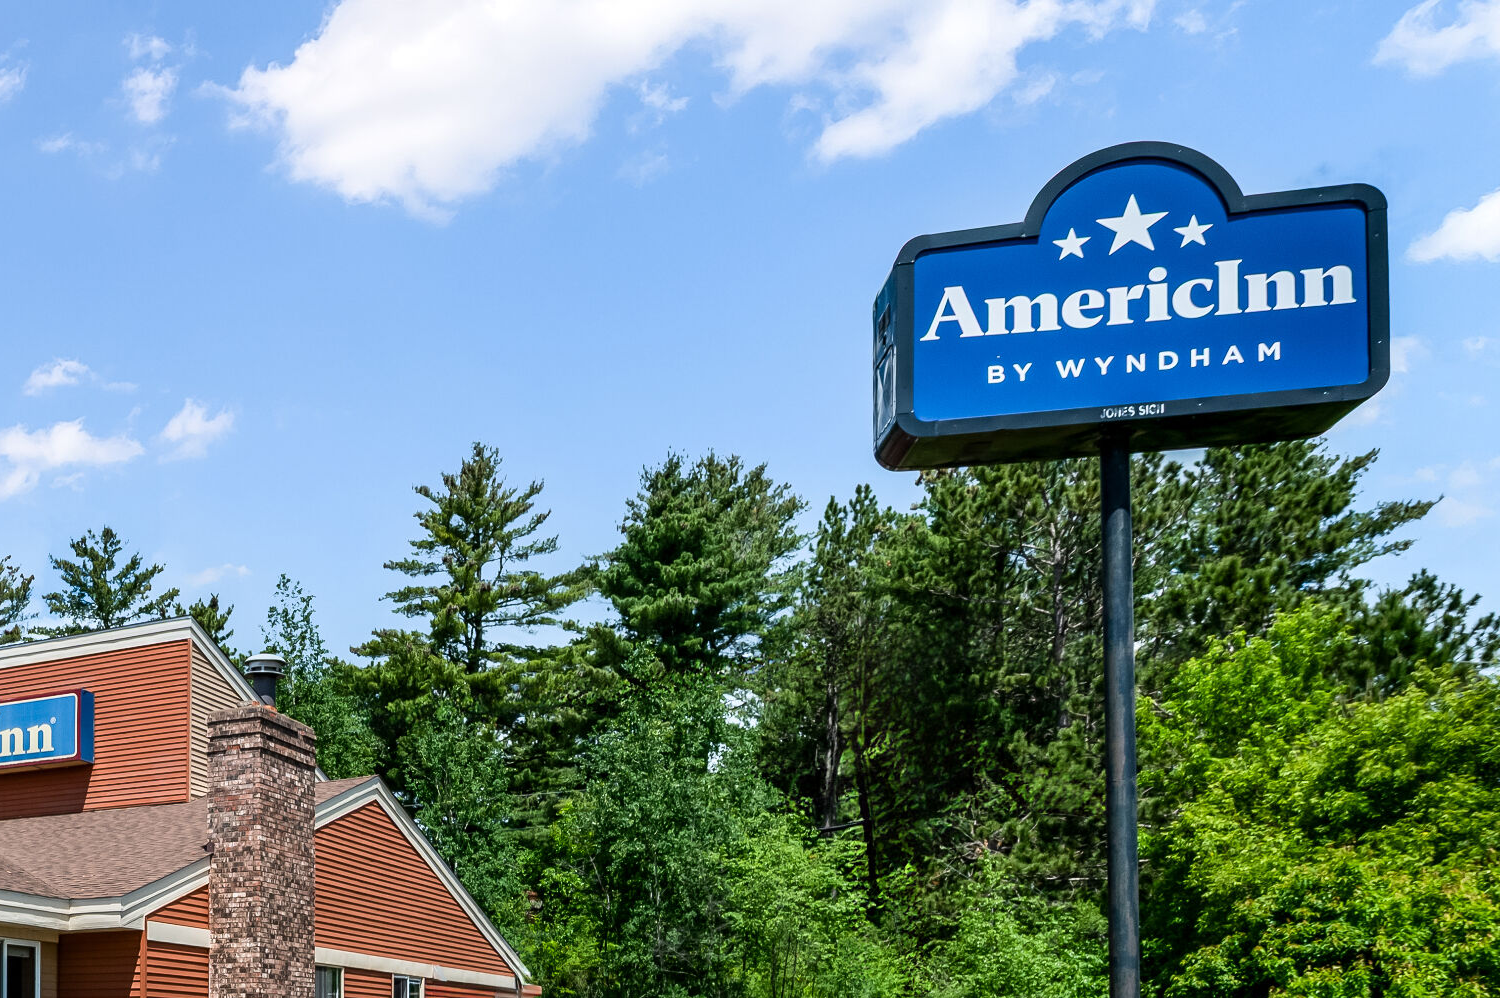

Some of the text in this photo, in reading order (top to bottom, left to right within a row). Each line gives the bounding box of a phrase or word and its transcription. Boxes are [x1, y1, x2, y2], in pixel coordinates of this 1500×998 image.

[919, 259, 1357, 342] AmericInn
[987, 341, 1282, 384] BY WYNDHAM
